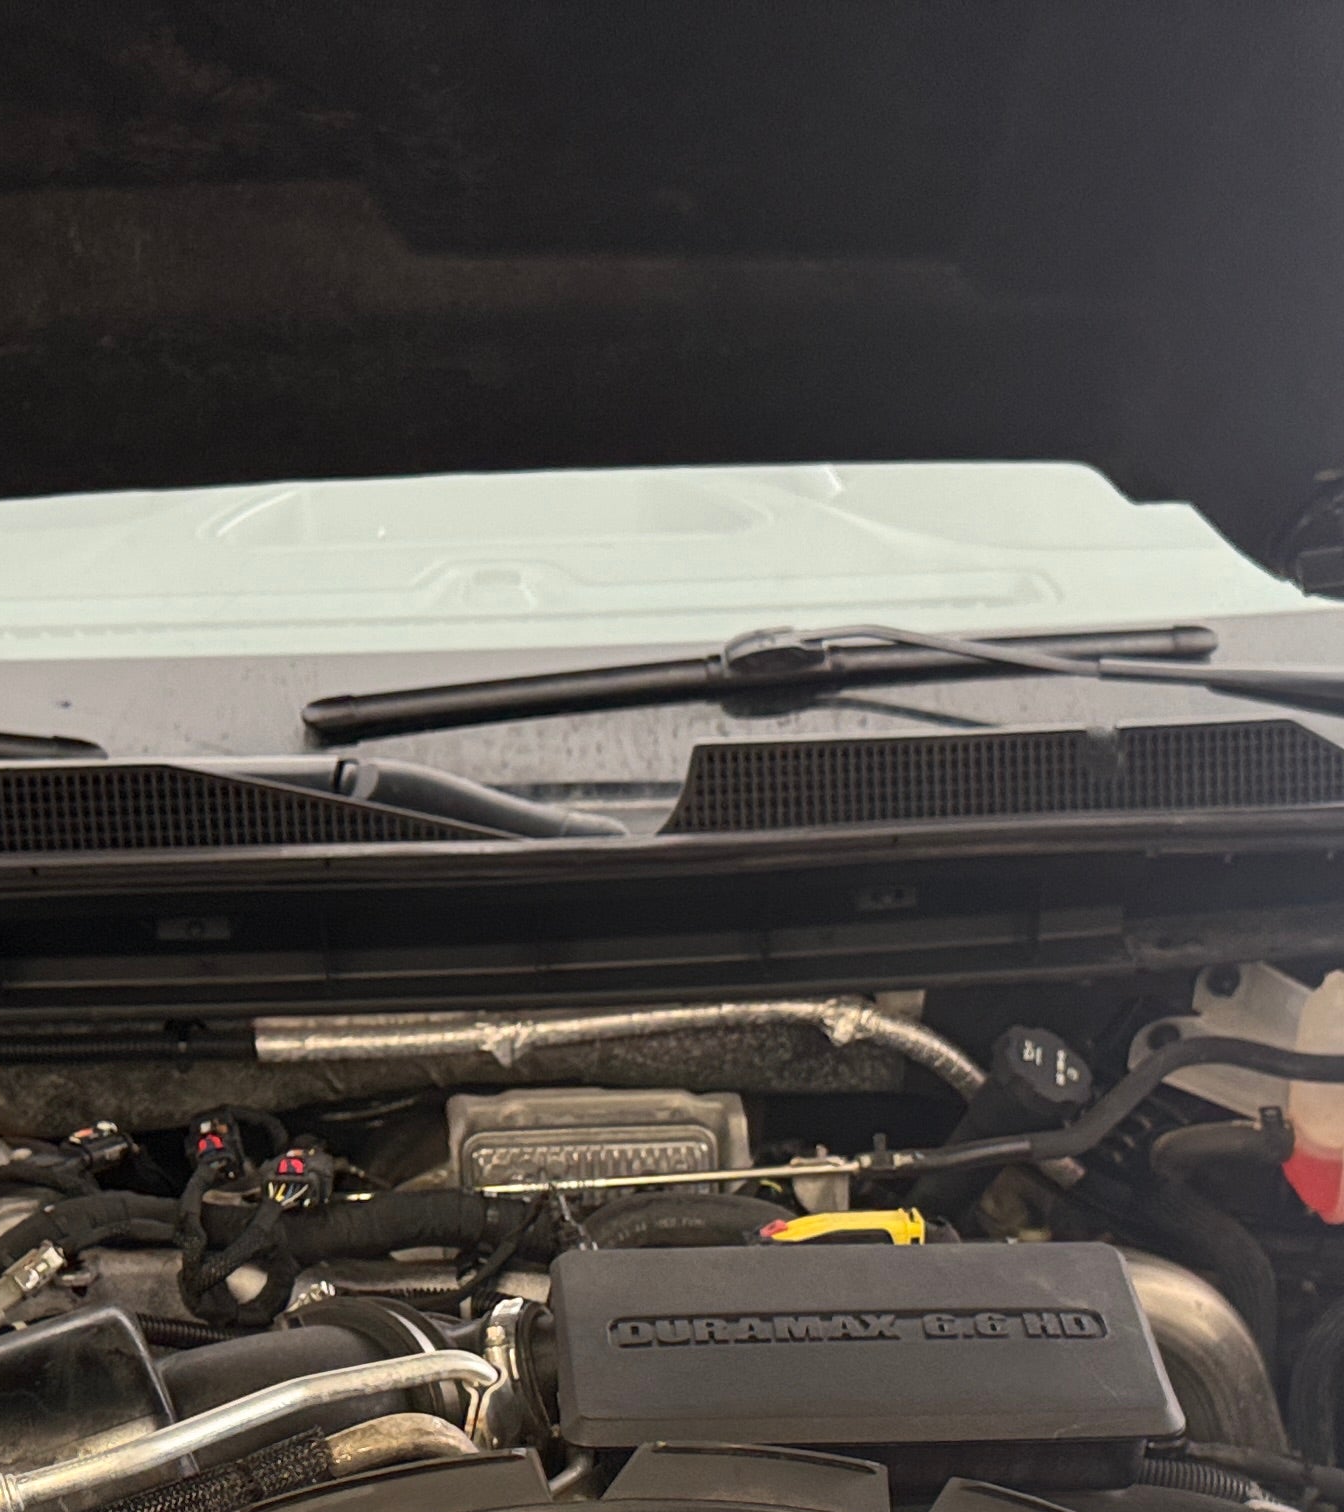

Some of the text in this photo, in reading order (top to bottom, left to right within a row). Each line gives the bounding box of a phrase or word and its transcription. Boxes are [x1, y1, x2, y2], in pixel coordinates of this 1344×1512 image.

[617, 1312, 1102, 1348] DURAMAX 6.6 HD
